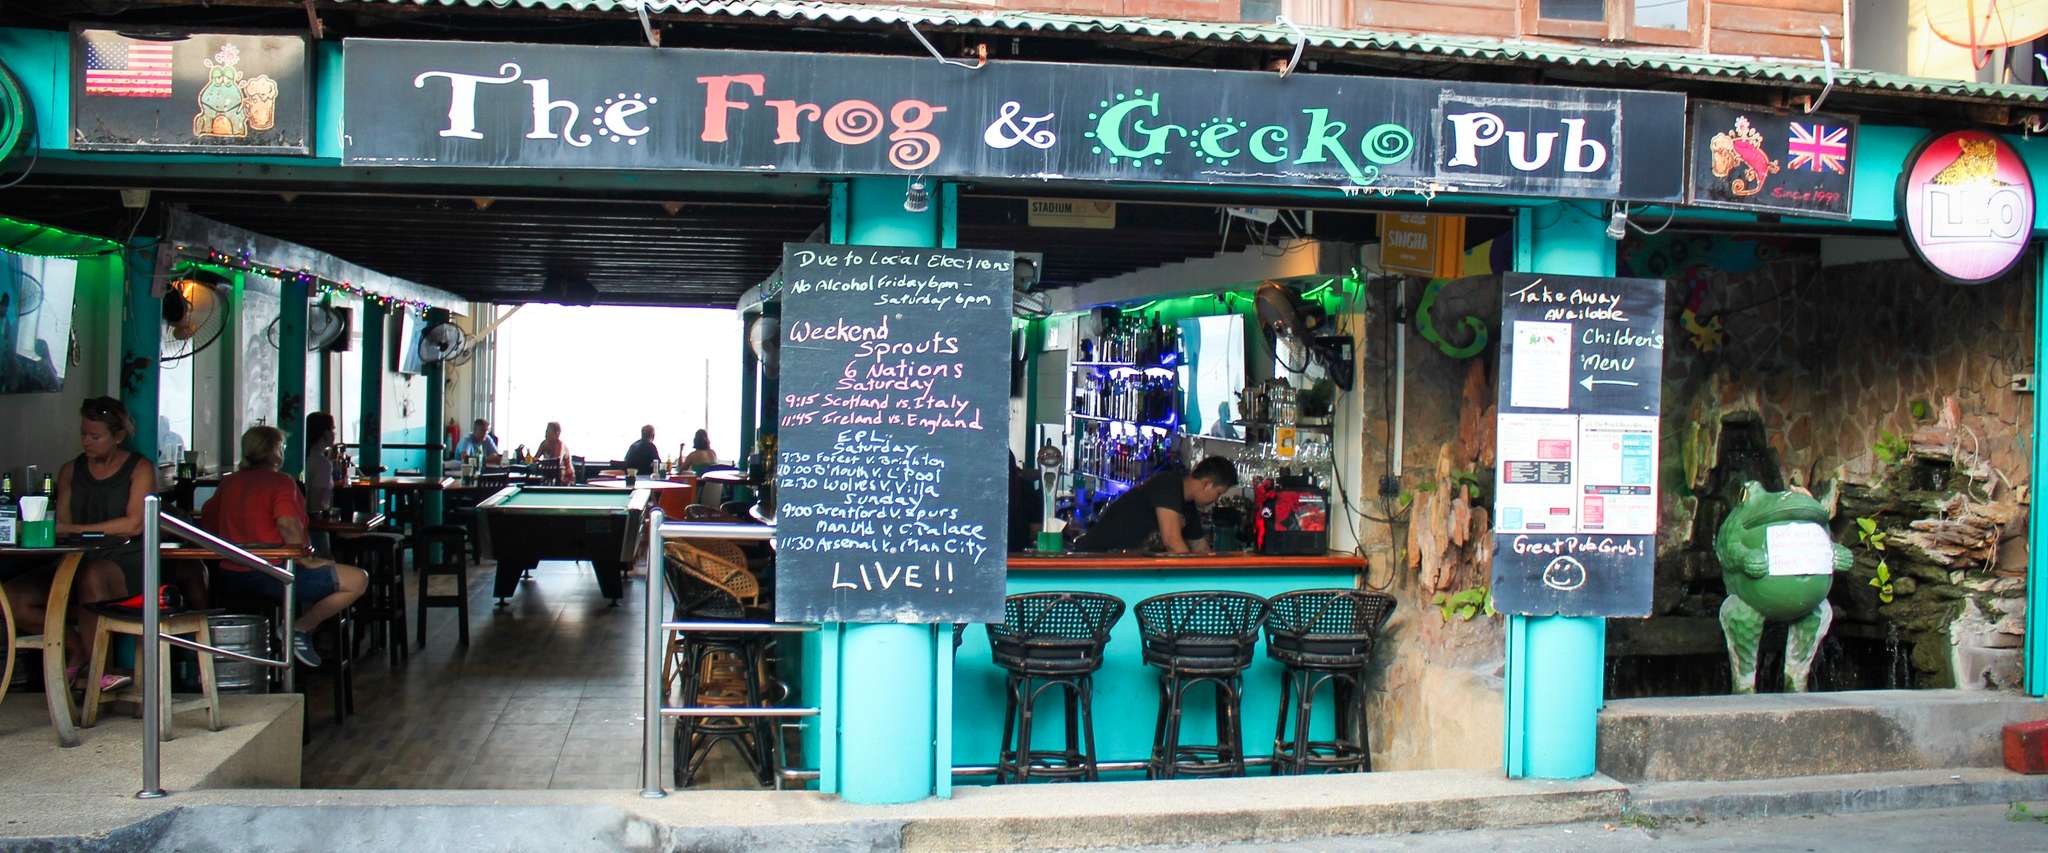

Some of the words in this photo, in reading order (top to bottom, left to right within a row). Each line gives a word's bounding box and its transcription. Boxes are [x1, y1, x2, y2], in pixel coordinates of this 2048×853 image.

[414, 63, 657, 146] The
[697, 73, 947, 169] Frog
[984, 101, 1056, 150] &
[1084, 87, 1413, 184] Gecko
[1447, 111, 1607, 173] Pub
[1770, 187, 1812, 202] Since
[1032, 201, 1072, 213] STADIUM
[1388, 230, 1428, 250] SINGHA
[794, 251, 838, 267] Due
[843, 250, 863, 266] to
[870, 251, 918, 267] Local
[791, 279, 811, 294] No
[815, 275, 874, 291] Alcohol
[877, 275, 924, 296] Friday
[928, 276, 959, 294] 6pm
[1509, 278, 1567, 303] Take
[1570, 289, 1621, 309] Away
[874, 293, 951, 311] Saturday
[955, 295, 991, 308] 6pm
[790, 315, 888, 342] Weekend
[1582, 327, 1664, 350] Children's
[854, 331, 959, 362] Sprouts
[845, 360, 857, 378] 6
[866, 359, 963, 379] Nations
[836, 376, 934, 399] Saturday
[785, 393, 820, 408] 9:15
[821, 393, 888, 410] Scotland
[911, 395, 968, 417] Italy
[781, 410, 820, 427] 11:45
[822, 410, 882, 425] Ireland
[908, 408, 983, 435] England
[816, 452, 860, 464] Forest
[877, 452, 945, 468] Brighton
[833, 441, 920, 458] Saturday
[780, 477, 818, 489] 12:30
[823, 478, 876, 492] Wolves
[895, 481, 939, 497] Villa
[782, 503, 812, 518] 9:00
[813, 503, 888, 520] Brentford
[844, 491, 924, 512] Sunday
[816, 537, 877, 552] Arsenal
[900, 538, 939, 553] Man
[944, 538, 988, 564] City
[1513, 534, 1565, 555] Great
[1565, 536, 1597, 553] Pub
[1598, 538, 1645, 557] Grub!
